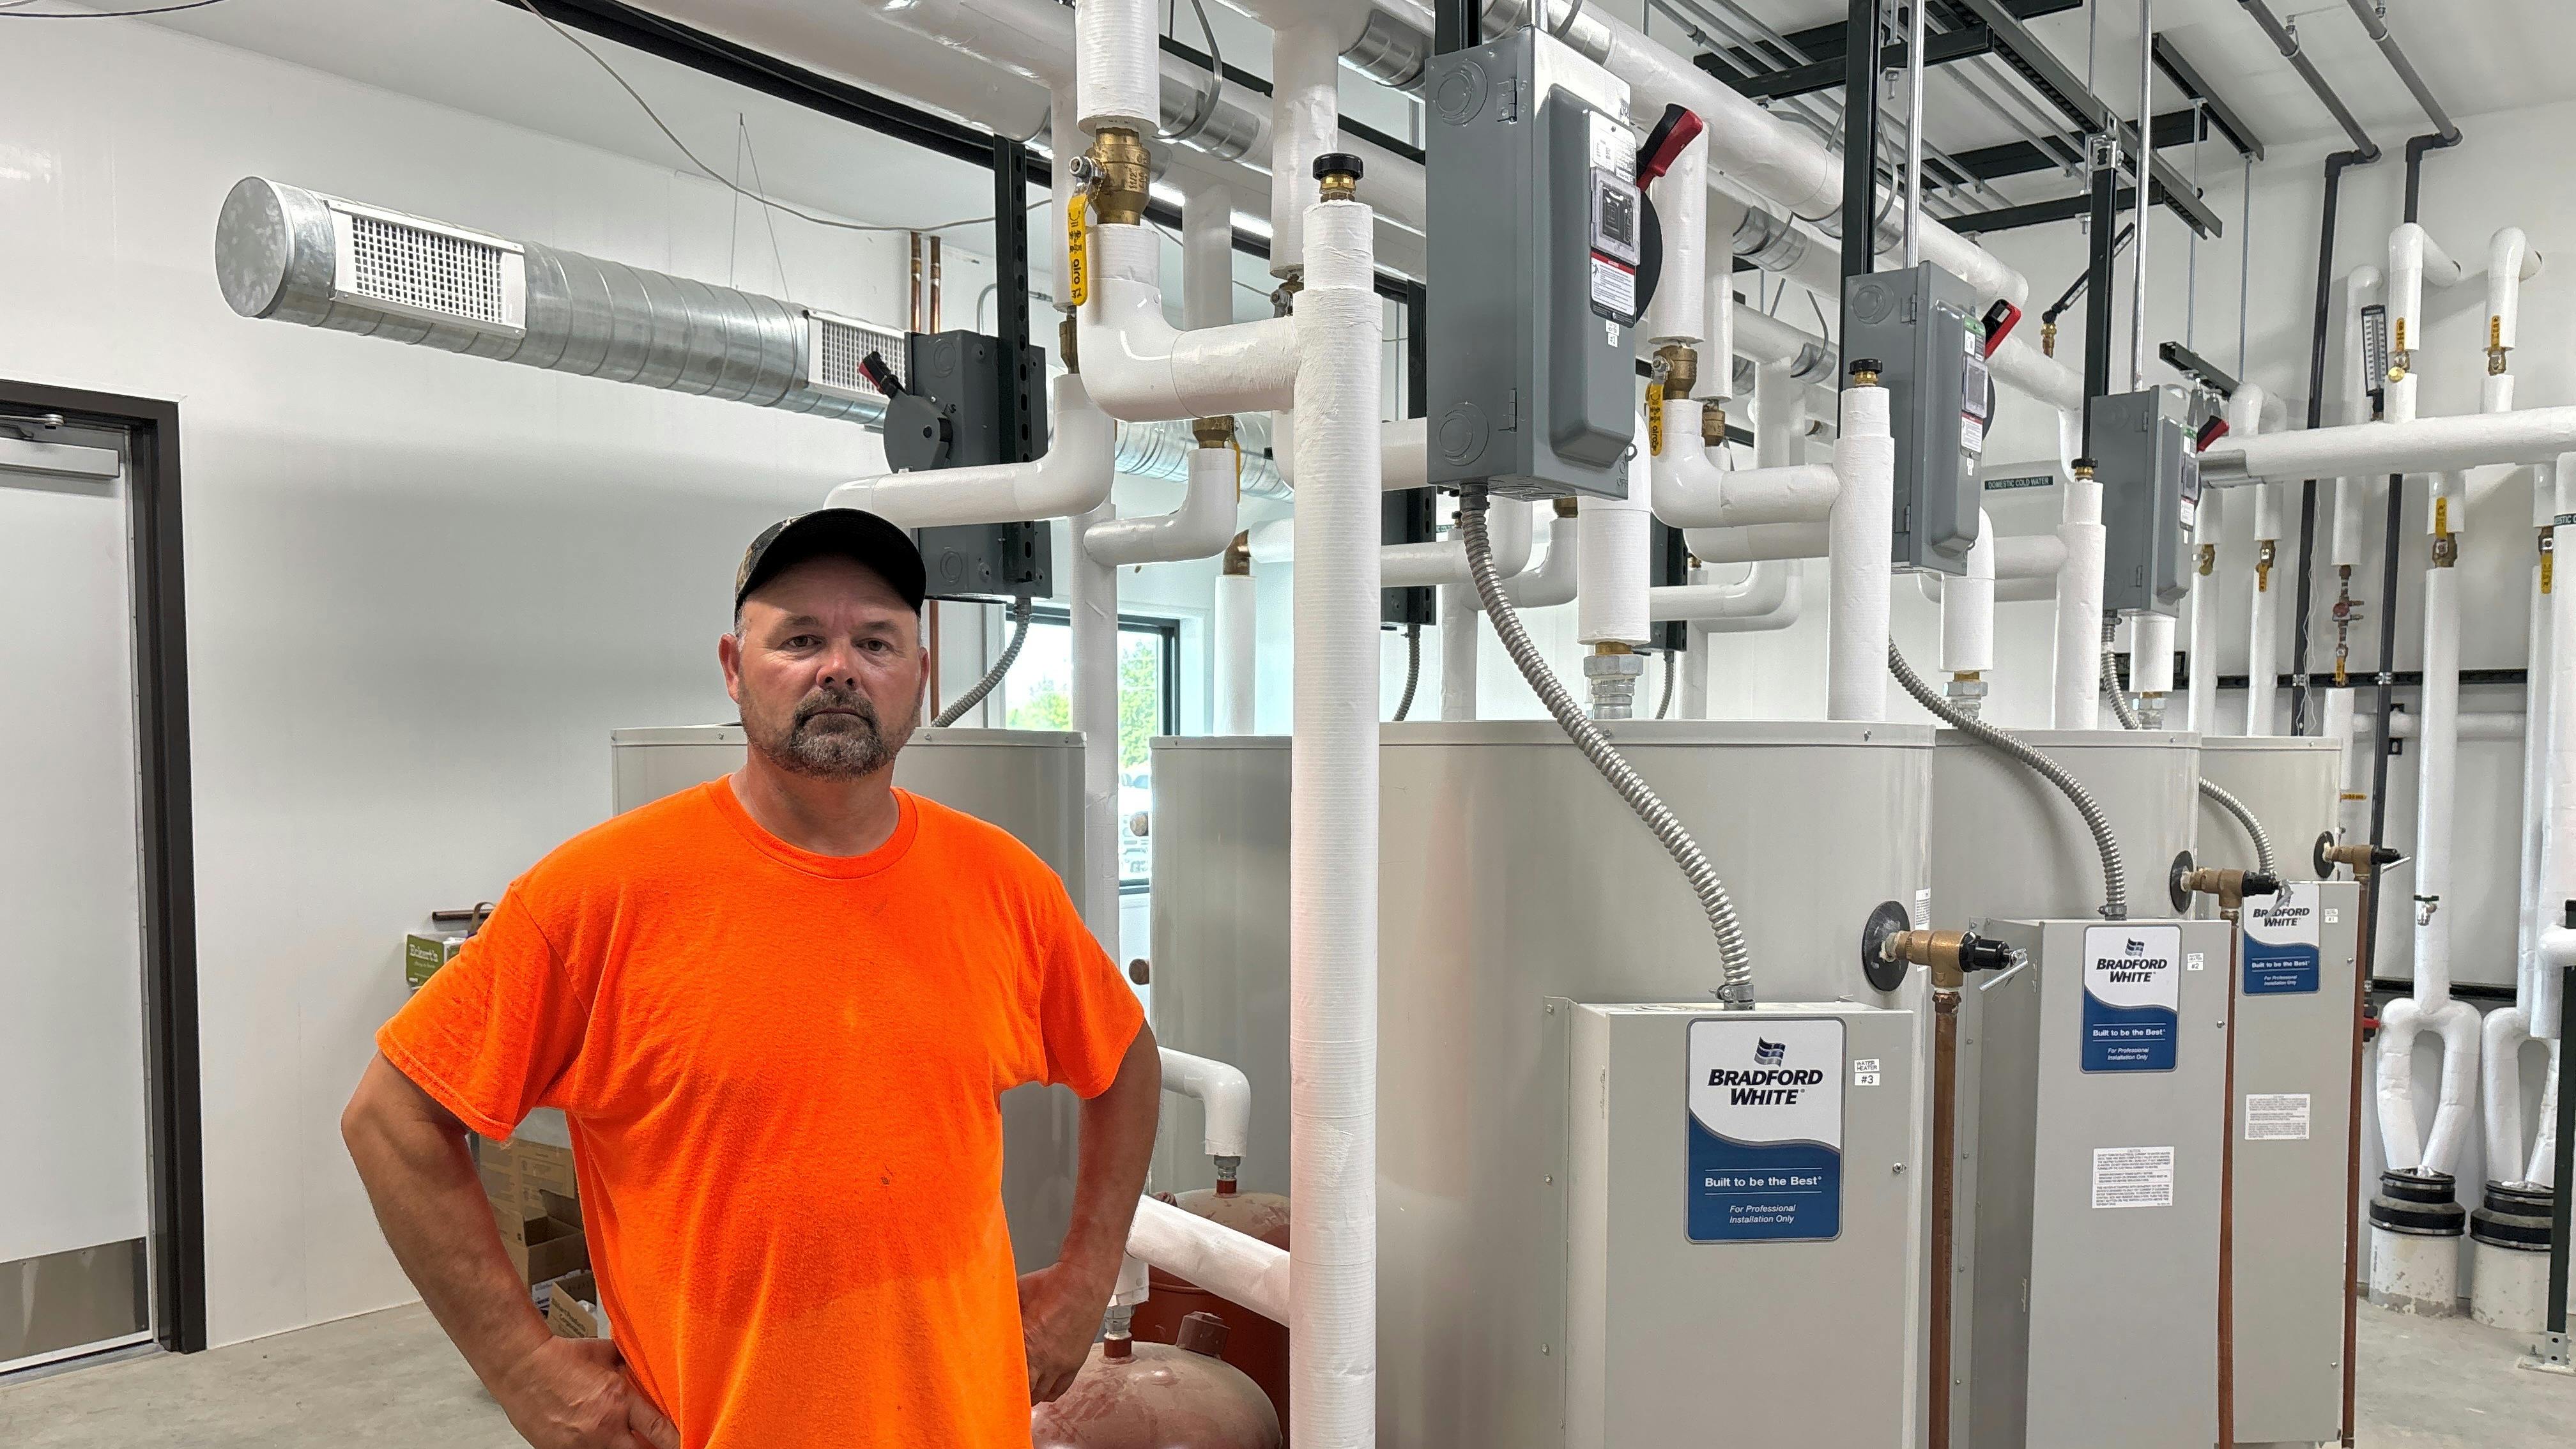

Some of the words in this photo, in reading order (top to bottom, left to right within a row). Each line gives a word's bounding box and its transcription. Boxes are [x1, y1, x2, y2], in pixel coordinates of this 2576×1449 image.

[1988, 479, 2014, 489] DOMESTIC
[2015, 479, 2030, 487] COLD
[2031, 477, 2049, 486] WATER
[2253, 907, 2310, 917] BRDFORD
[2264, 917, 2297, 927] WHITE
[2096, 958, 2167, 970] BRADFORD
[2110, 971, 2152, 983] WHITE
[1708, 1069, 1823, 1085] BRADFORD
[1861, 1075, 1873, 1084] #3
[1731, 1088, 1798, 1105] WHITE
[1705, 1177, 1731, 1187] Built
[1749, 1177, 1764, 1186] be
[1768, 1176, 1786, 1186] the
[1790, 1176, 1818, 1185] Best
[1745, 1204, 1796, 1213] Professional
[1775, 1215, 1795, 1224] Only
